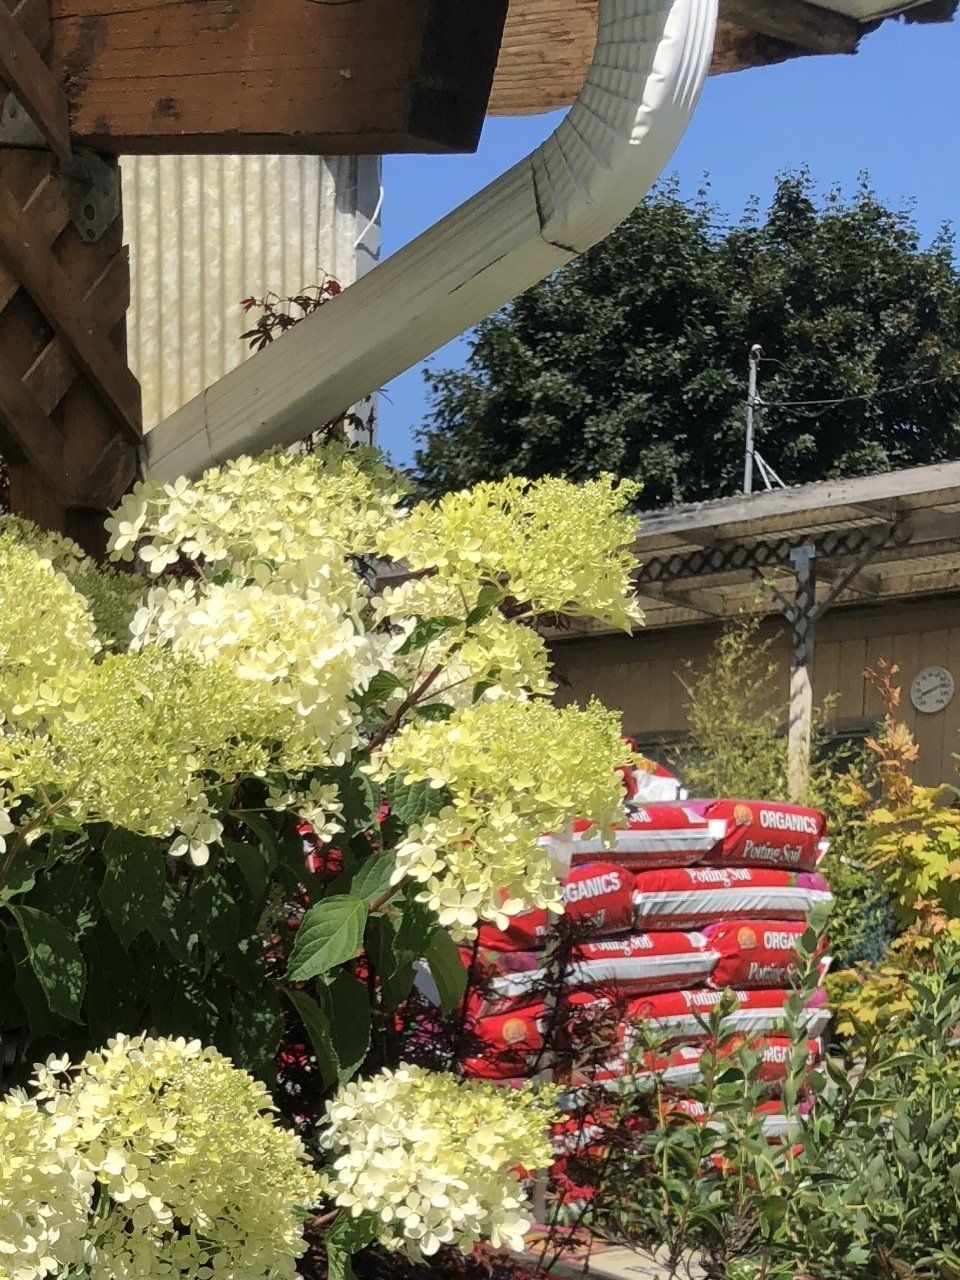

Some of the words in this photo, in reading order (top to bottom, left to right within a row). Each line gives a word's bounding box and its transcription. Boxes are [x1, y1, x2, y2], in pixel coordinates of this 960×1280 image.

[760, 809, 818, 835] ORGANICS
[743, 840, 782, 863] Potting
[782, 843, 802, 863] Soil
[685, 867, 732, 887] Potting
[731, 868, 752, 881] Soil
